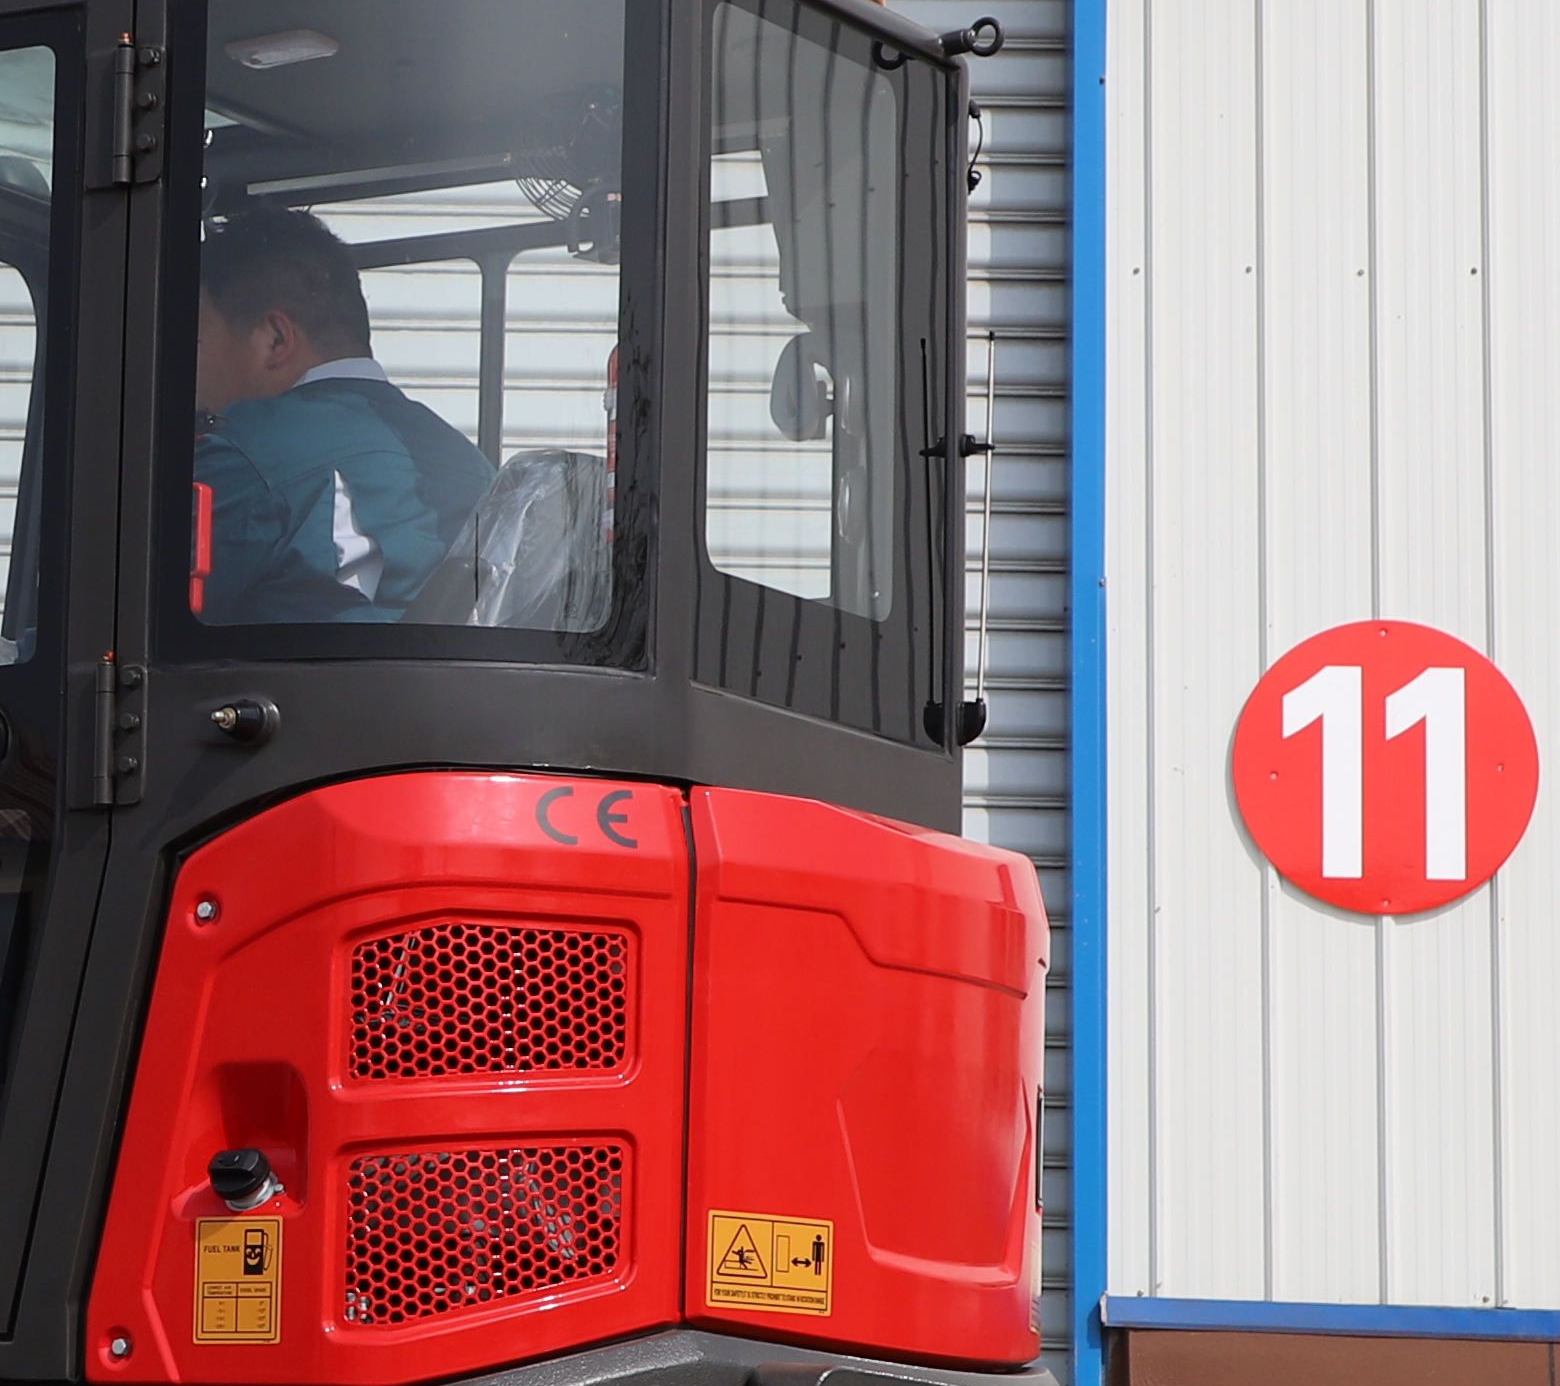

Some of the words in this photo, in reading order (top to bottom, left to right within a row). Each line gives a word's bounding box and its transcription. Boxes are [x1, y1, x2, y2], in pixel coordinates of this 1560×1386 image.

[1282, 665, 1467, 880] 11
[535, 786, 638, 849] CE
[203, 1245, 221, 1253] FUEL
[223, 1244, 241, 1253] TANK
